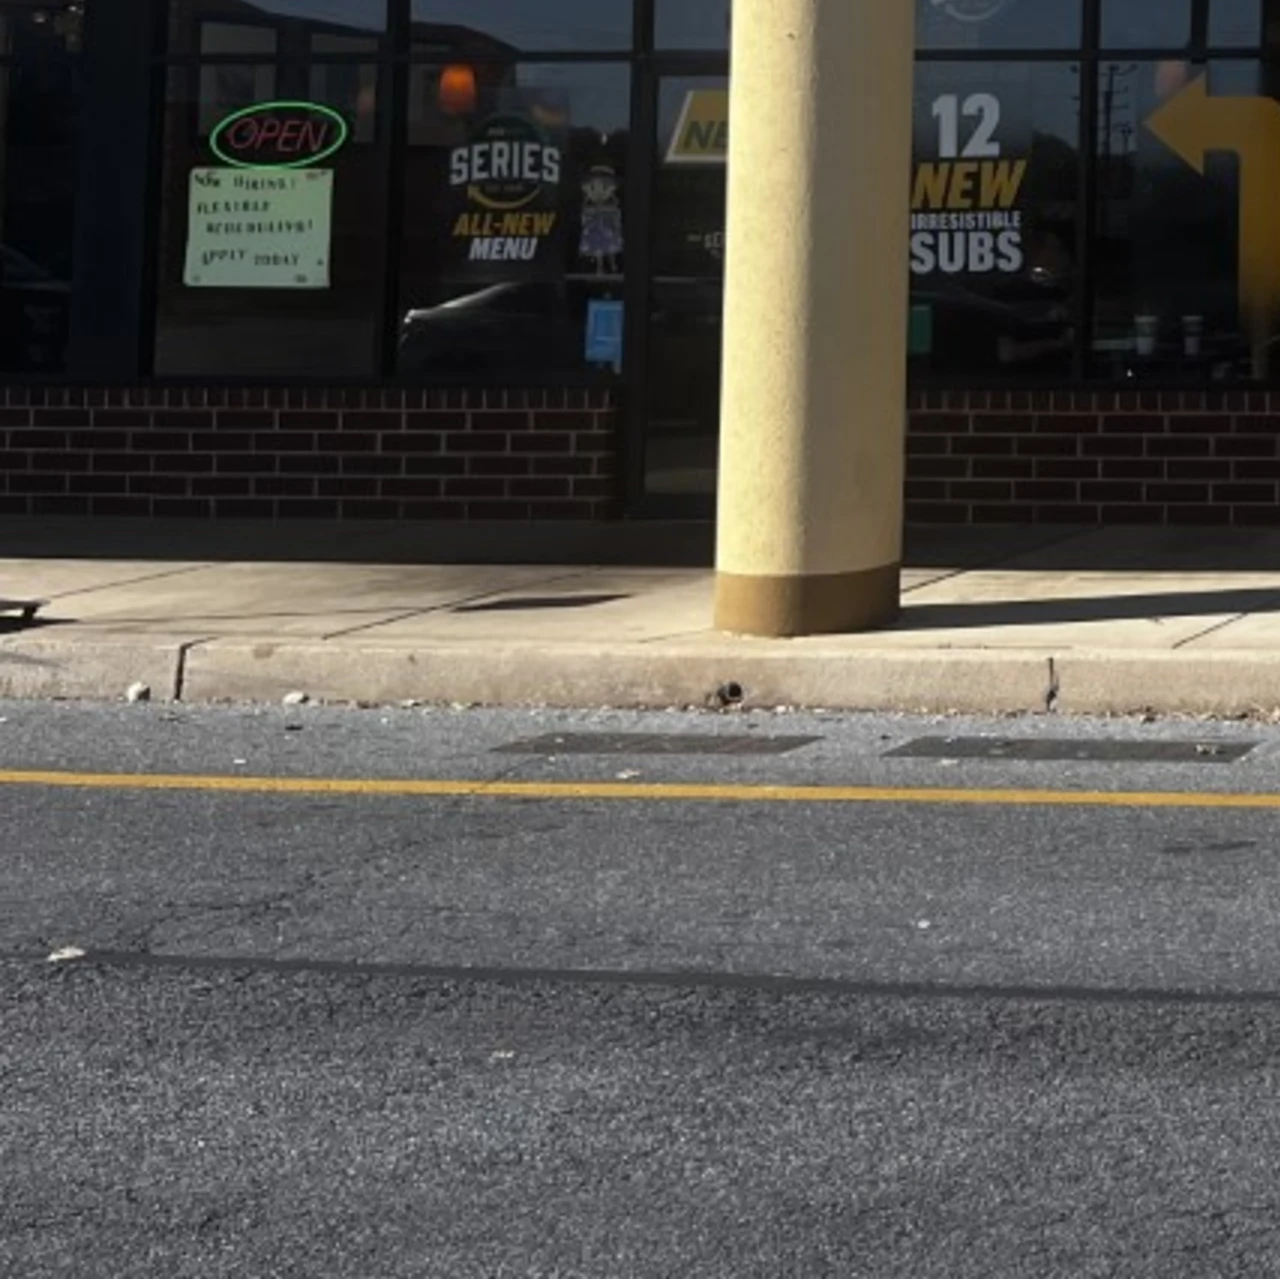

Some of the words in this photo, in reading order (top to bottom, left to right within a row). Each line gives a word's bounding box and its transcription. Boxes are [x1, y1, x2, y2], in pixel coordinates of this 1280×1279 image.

[225, 116, 329, 153] OPEN
[683, 120, 729, 150] NE
[931, 93, 1001, 158] 12
[449, 140, 562, 186] SERIES
[911, 159, 1027, 209] NEW
[452, 212, 556, 236] ALL-NEW
[911, 210, 1022, 230] IRRESISTIBLE
[468, 237, 538, 261] MENU
[911, 231, 1024, 274] SUBS
